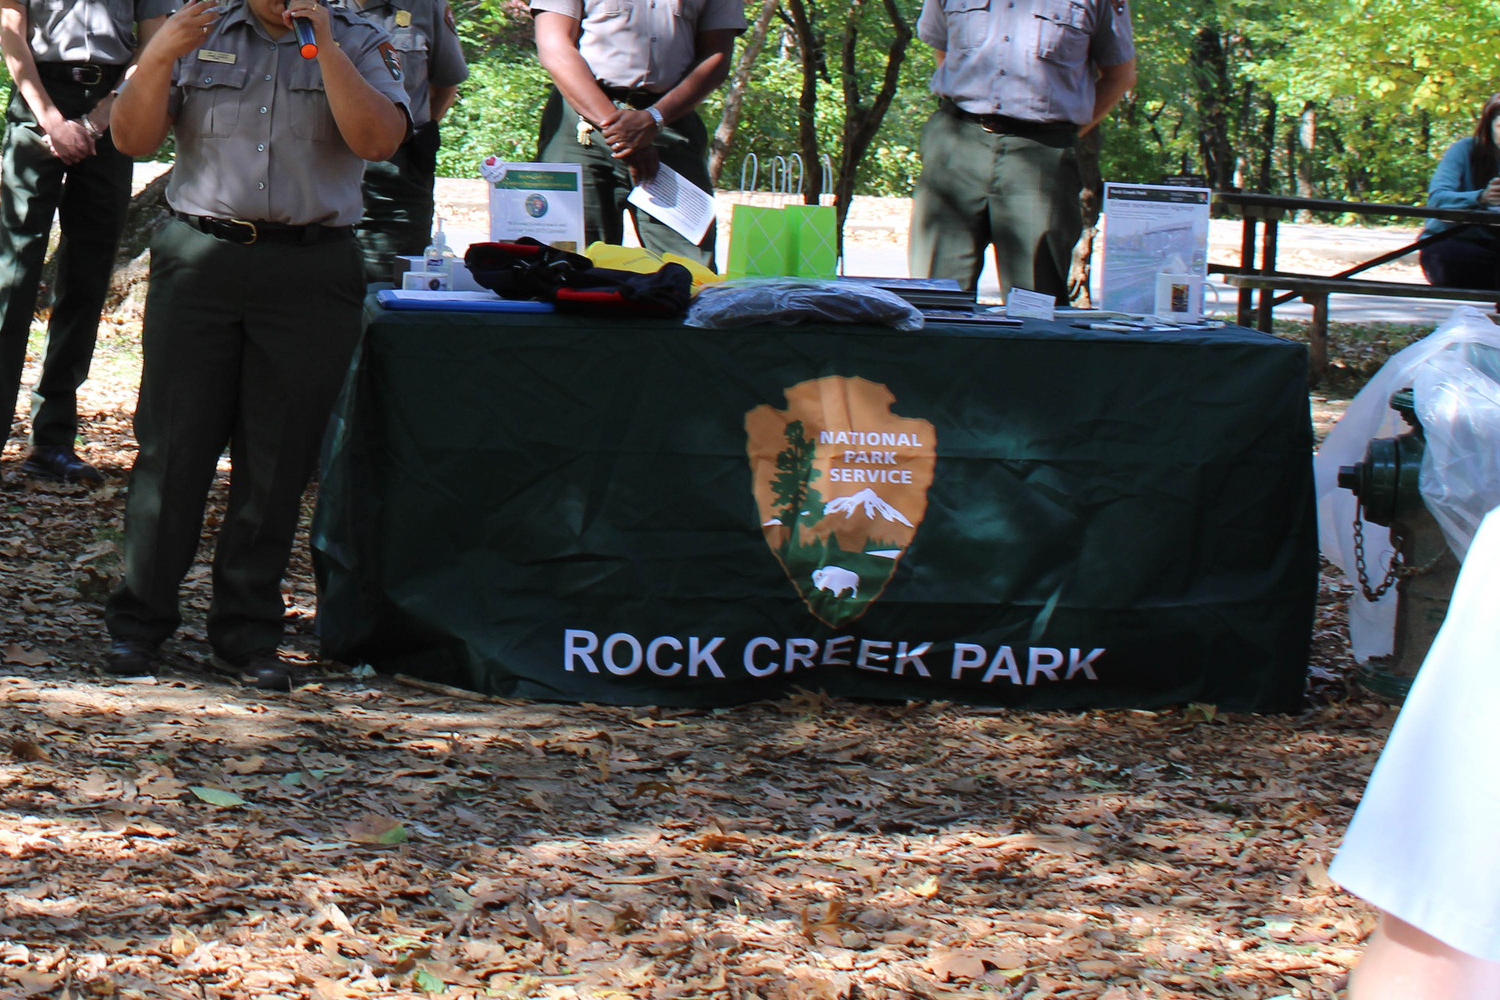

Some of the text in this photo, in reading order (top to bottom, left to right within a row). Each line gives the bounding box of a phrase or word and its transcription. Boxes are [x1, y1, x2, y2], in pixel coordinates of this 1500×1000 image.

[820, 430, 923, 447] NATIONAL
[844, 450, 898, 465] PARK
[829, 468, 913, 484] SERVICE
[563, 628, 1106, 686] ROCK CREEK PARK
